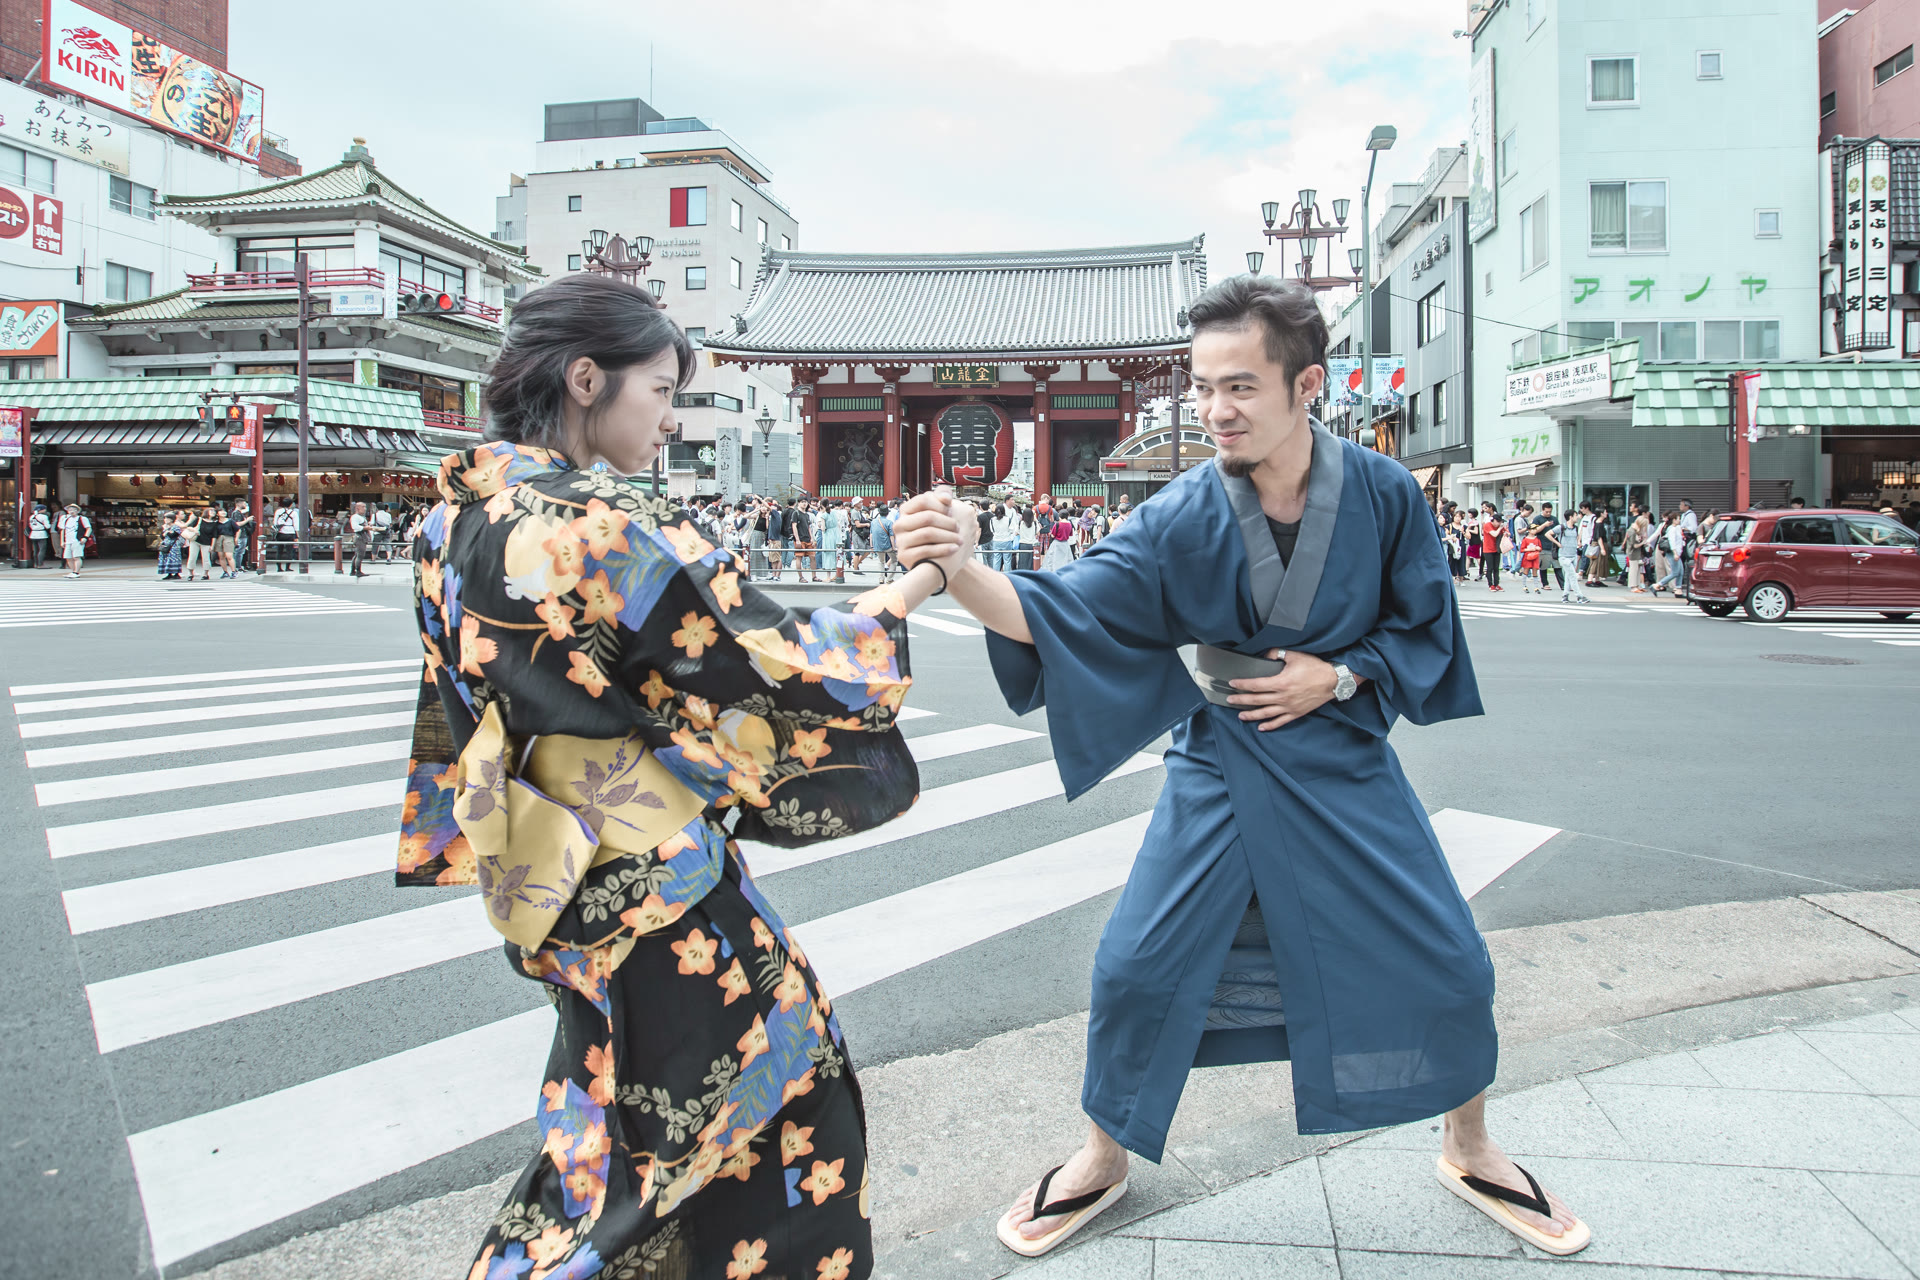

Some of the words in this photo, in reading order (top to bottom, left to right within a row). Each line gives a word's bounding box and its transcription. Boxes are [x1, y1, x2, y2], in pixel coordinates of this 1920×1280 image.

[57, 48, 125, 92] KIRIN
[34, 99, 112, 137] あんみつ
[25, 118, 93, 155] お抹茶
[660, 248, 701, 260] Ryokan
[1573, 275, 1767, 304] アオノヤ
[1509, 376, 1530, 390] 地下鉄
[1545, 368, 1570, 383] 銀座線
[1572, 361, 1598, 377] 浅草駅
[1572, 376, 1596, 386] Asakusa
[937, 404, 1003, 485] 雷門
[1511, 432, 1550, 457] アオノヤ
